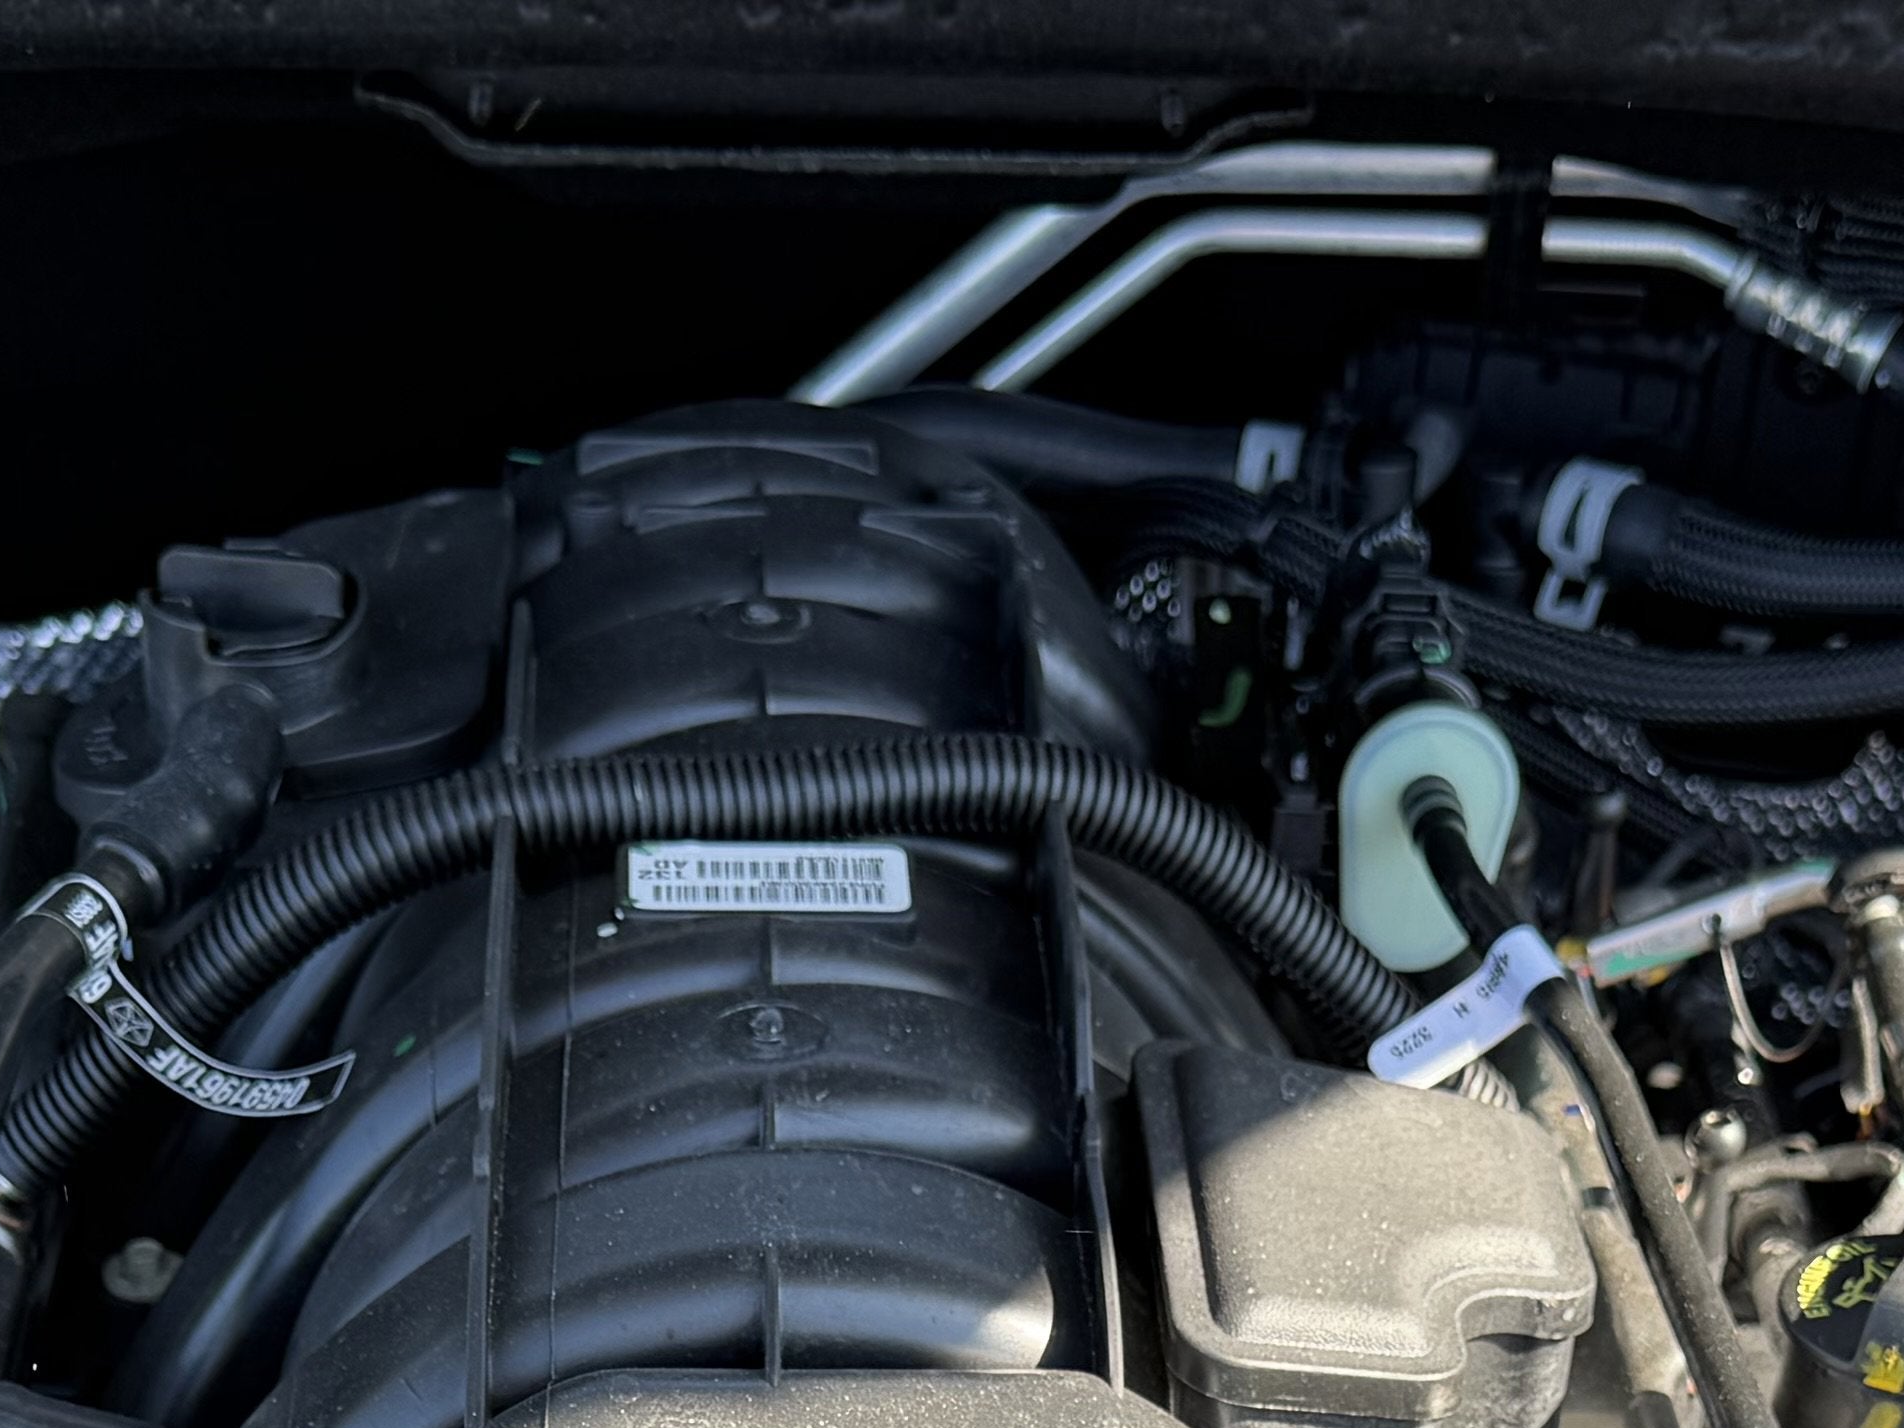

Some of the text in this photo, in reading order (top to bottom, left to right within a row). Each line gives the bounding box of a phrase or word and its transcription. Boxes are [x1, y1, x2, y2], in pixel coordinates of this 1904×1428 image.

[146, 1045, 312, 1110] 04591961AF
[1796, 1240, 1879, 1318] ENGINE OIL
